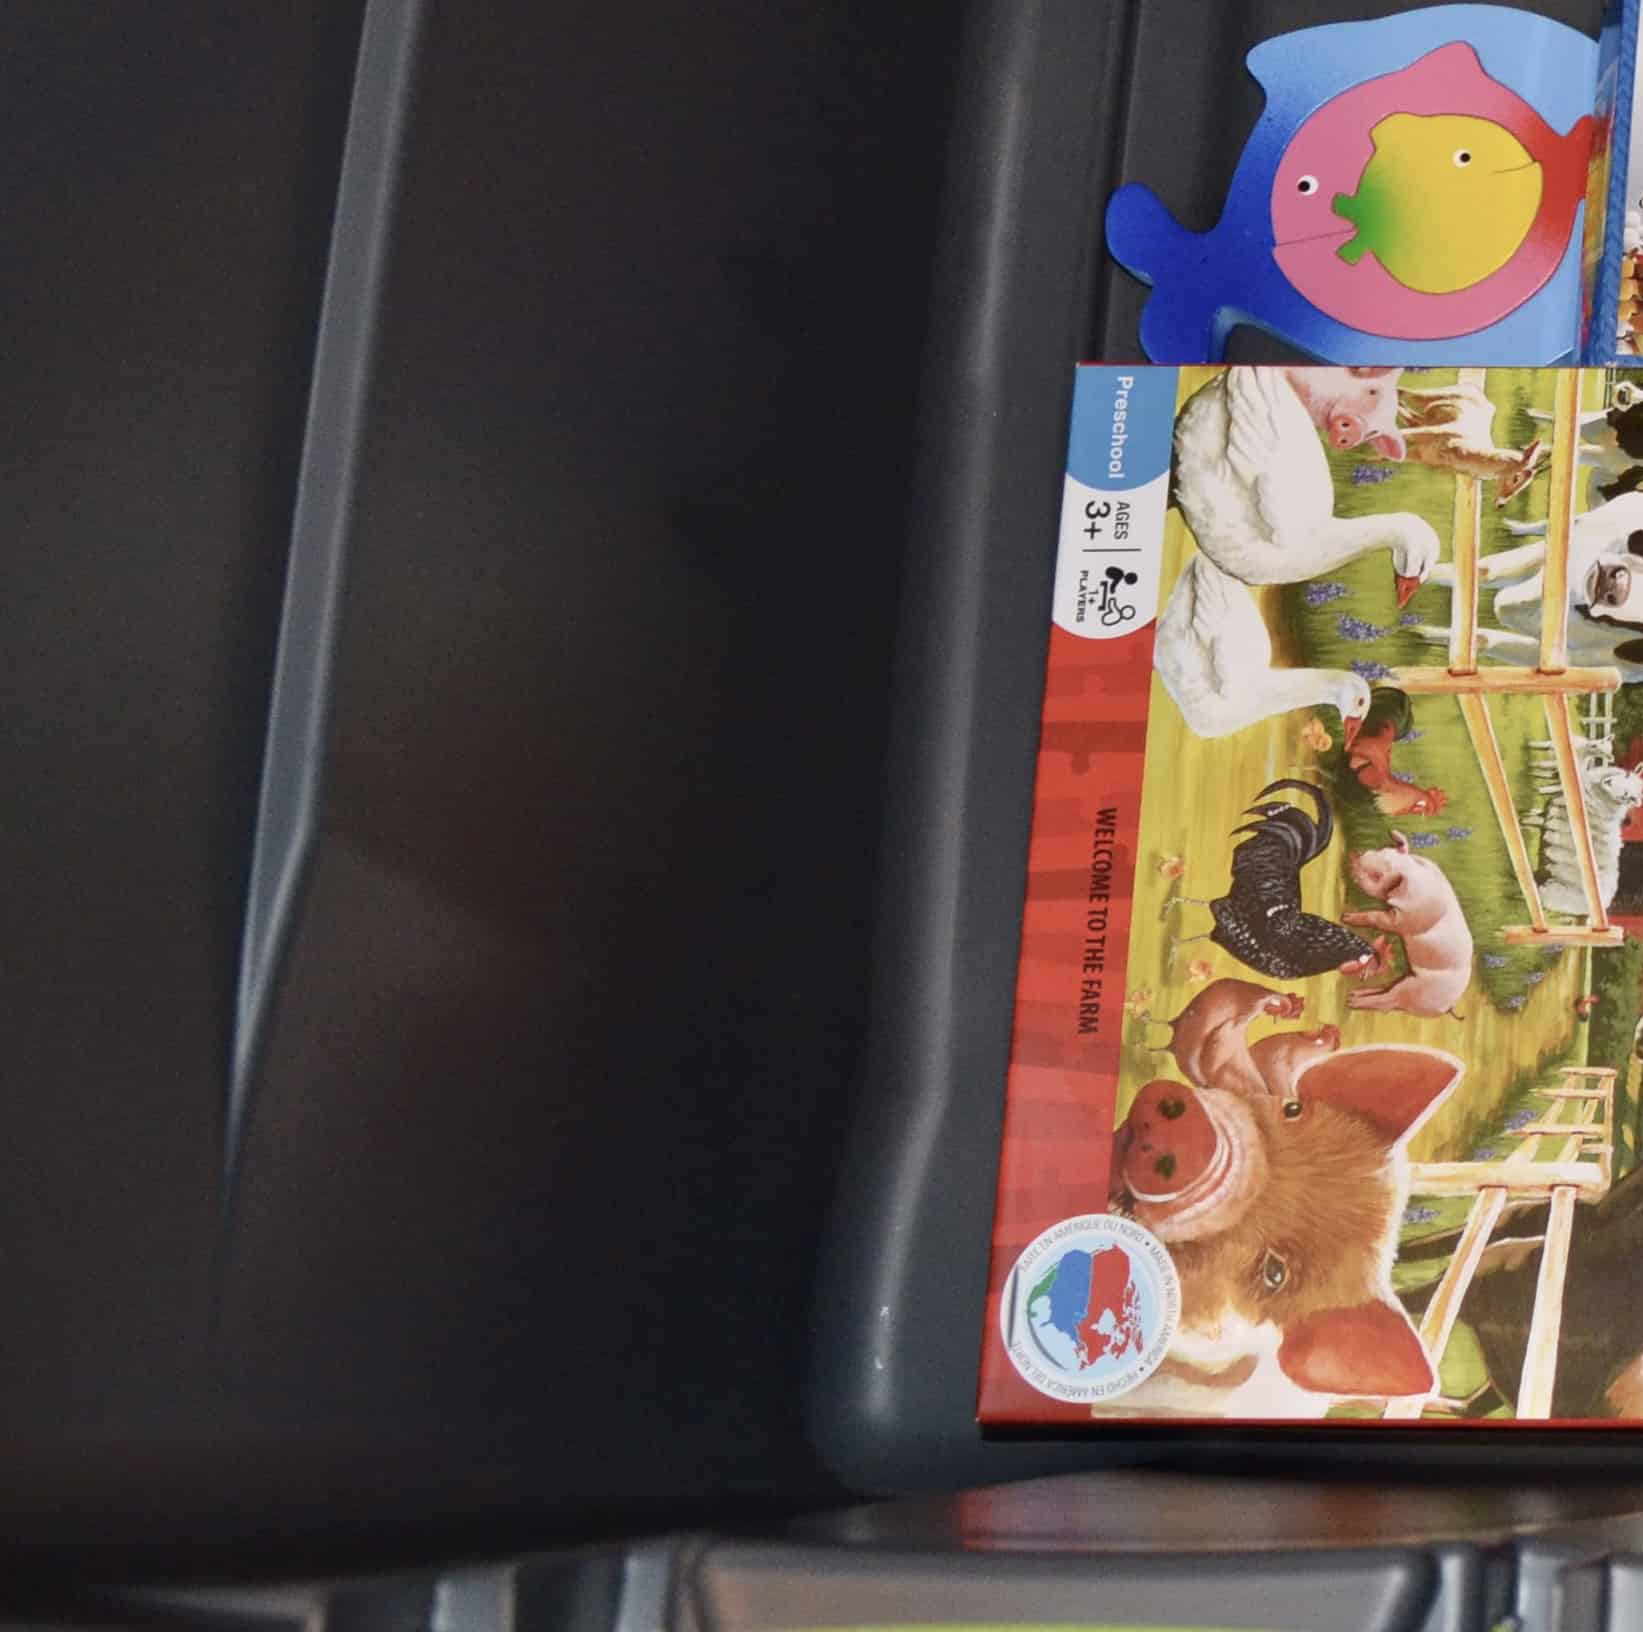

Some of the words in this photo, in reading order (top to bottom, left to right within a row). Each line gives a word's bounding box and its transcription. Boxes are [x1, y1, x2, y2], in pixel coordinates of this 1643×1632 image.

[1107, 375, 1135, 480] Preschool
[1083, 500, 1111, 540] 3+
[1113, 500, 1131, 540] AGES
[1075, 570, 1089, 623] PLAYERS
[1088, 589, 1099, 605] 1+
[1088, 807, 1117, 903] WELCOME
[1087, 908, 1109, 933] TO
[1082, 935, 1106, 974] THE
[1078, 979, 1104, 1035] FARM
